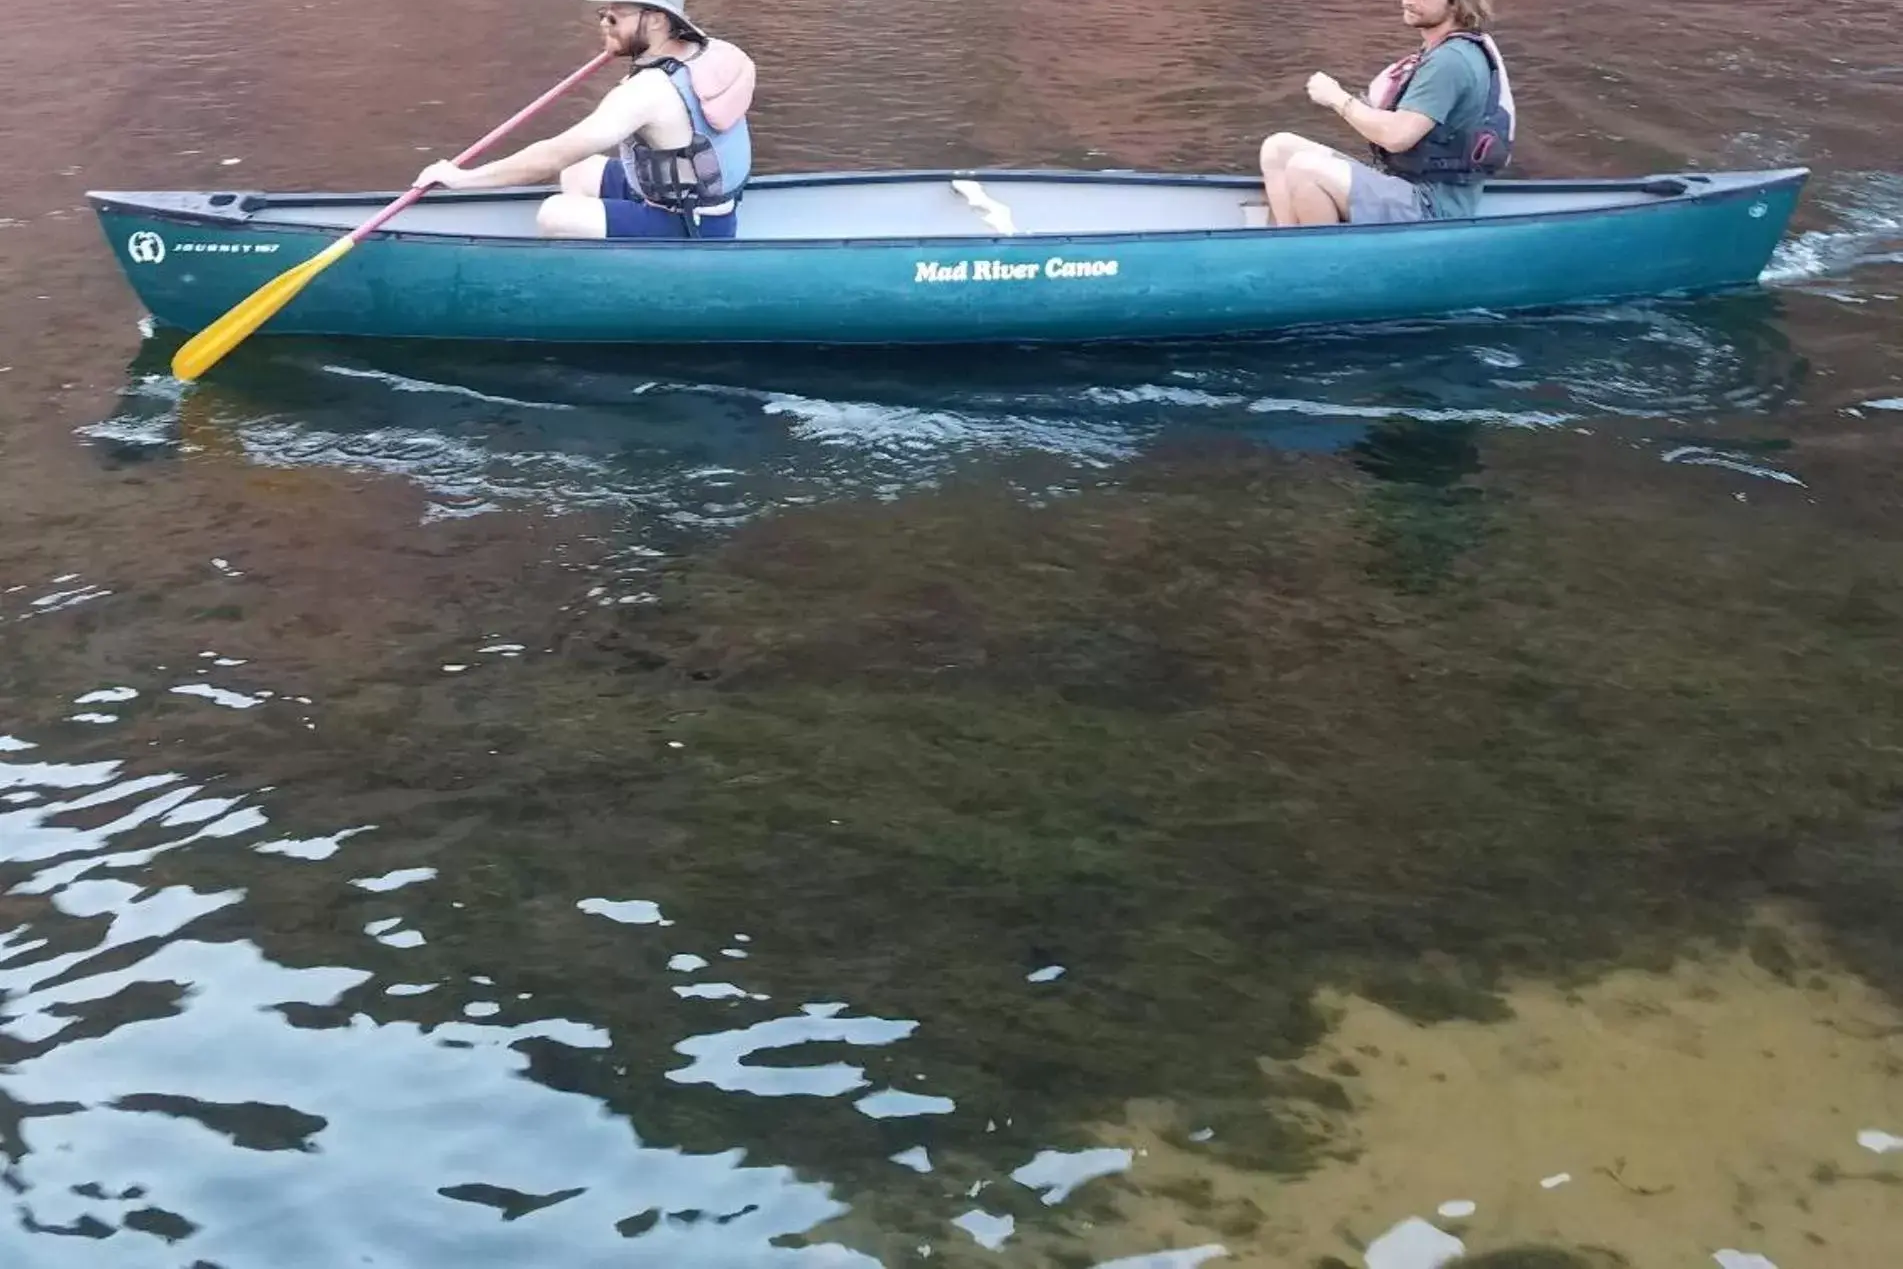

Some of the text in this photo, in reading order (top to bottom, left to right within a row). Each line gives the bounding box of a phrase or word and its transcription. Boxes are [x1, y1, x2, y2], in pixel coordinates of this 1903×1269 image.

[172, 243, 252, 253] JOURNEY
[914, 257, 1119, 282] Mad River Canoe
